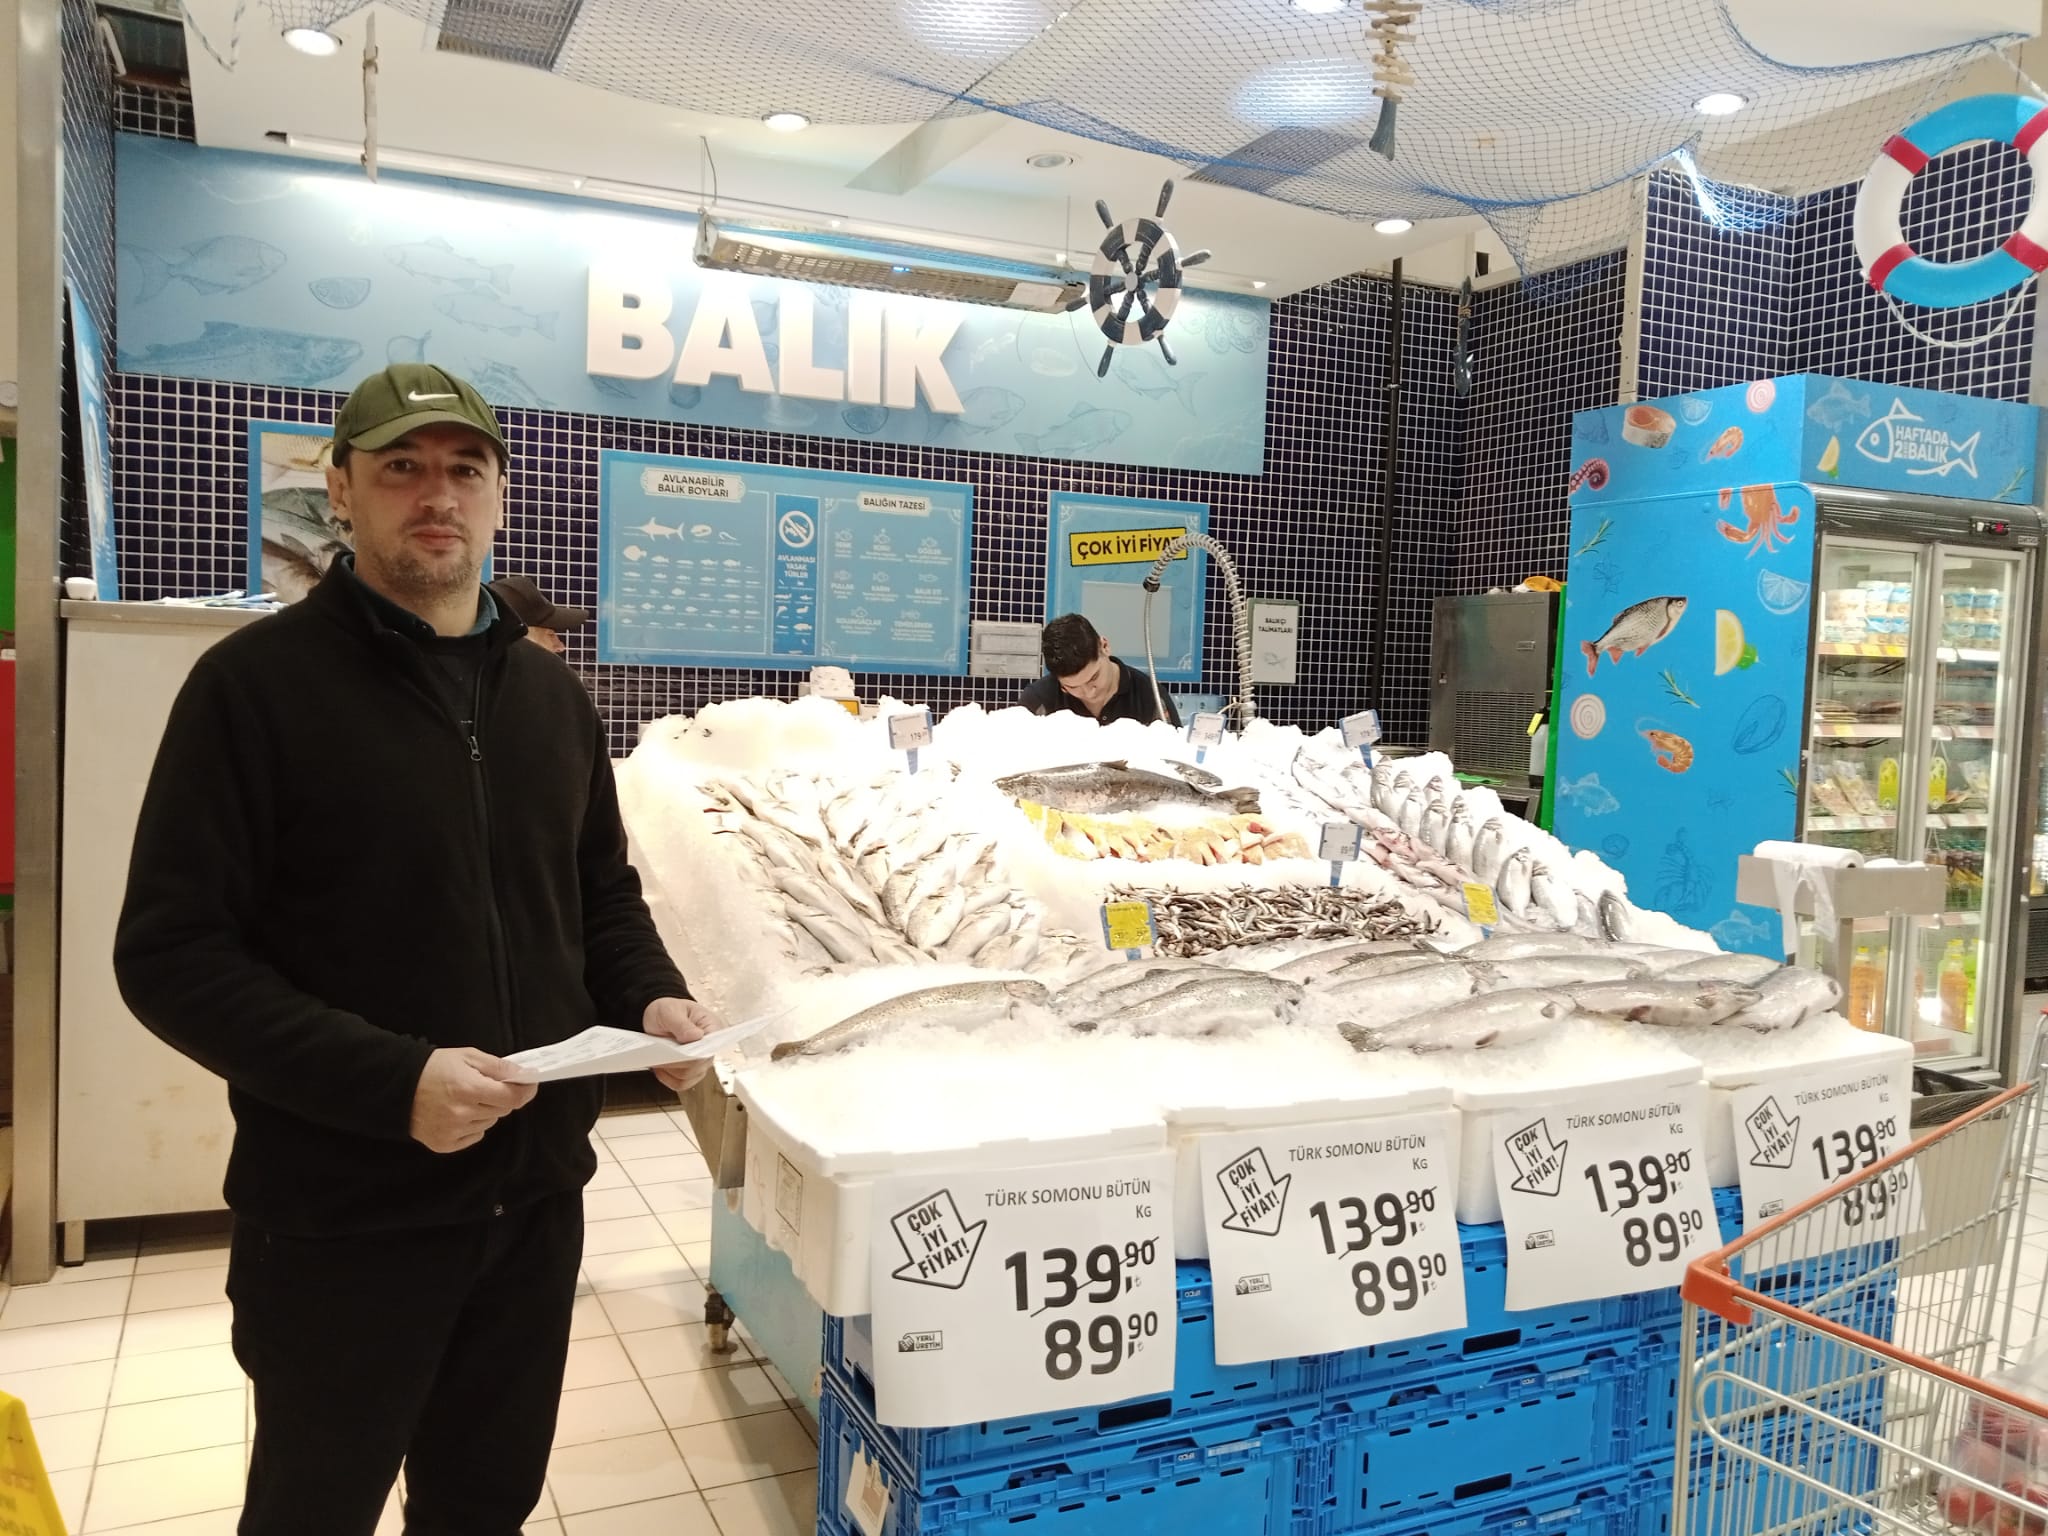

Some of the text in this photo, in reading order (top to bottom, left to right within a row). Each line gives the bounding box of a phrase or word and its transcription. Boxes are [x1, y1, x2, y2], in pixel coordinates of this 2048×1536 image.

[586, 264, 966, 415] BALIK
[1895, 425, 1949, 446] HAFTADA
[1894, 440, 1903, 459] 2
[1909, 442, 1949, 464] BALIK
[658, 483, 729, 498] BALIK BOYLARI
[662, 474, 725, 488] AVLANABİLİR
[863, 497, 926, 511] BALIĞIN TAZESİ
[1077, 540, 1112, 560] ÇOK
[1117, 535, 1136, 554] İYİ
[1794, 1074, 1888, 1106] TÜRK SOMONU BÜTÜN
[1566, 1103, 1681, 1129] TÜRK SOMONU BÜTÜN
[1753, 1106, 1773, 1130] ÇOK
[1514, 1128, 1538, 1151] ÇOK
[1763, 1123, 1778, 1142] İYİ
[1289, 1134, 1426, 1162] TÜRK SOMONU BÜTÜN
[1522, 1144, 1541, 1167] İYİ
[1763, 1130, 1793, 1163] FİYAT!
[1228, 1158, 1257, 1188] ÇOK
[1526, 1155, 1559, 1190] FİYAT!
[985, 1180, 1151, 1207] TÜRK SOMONU BÜTÜN
[1239, 1179, 1261, 1203] İYİ
[907, 1201, 943, 1235] ÇOK
[1240, 1190, 1280, 1228] FİYAT!
[921, 1224, 948, 1252] İYİ
[917, 1237, 970, 1279] FİYAT!
